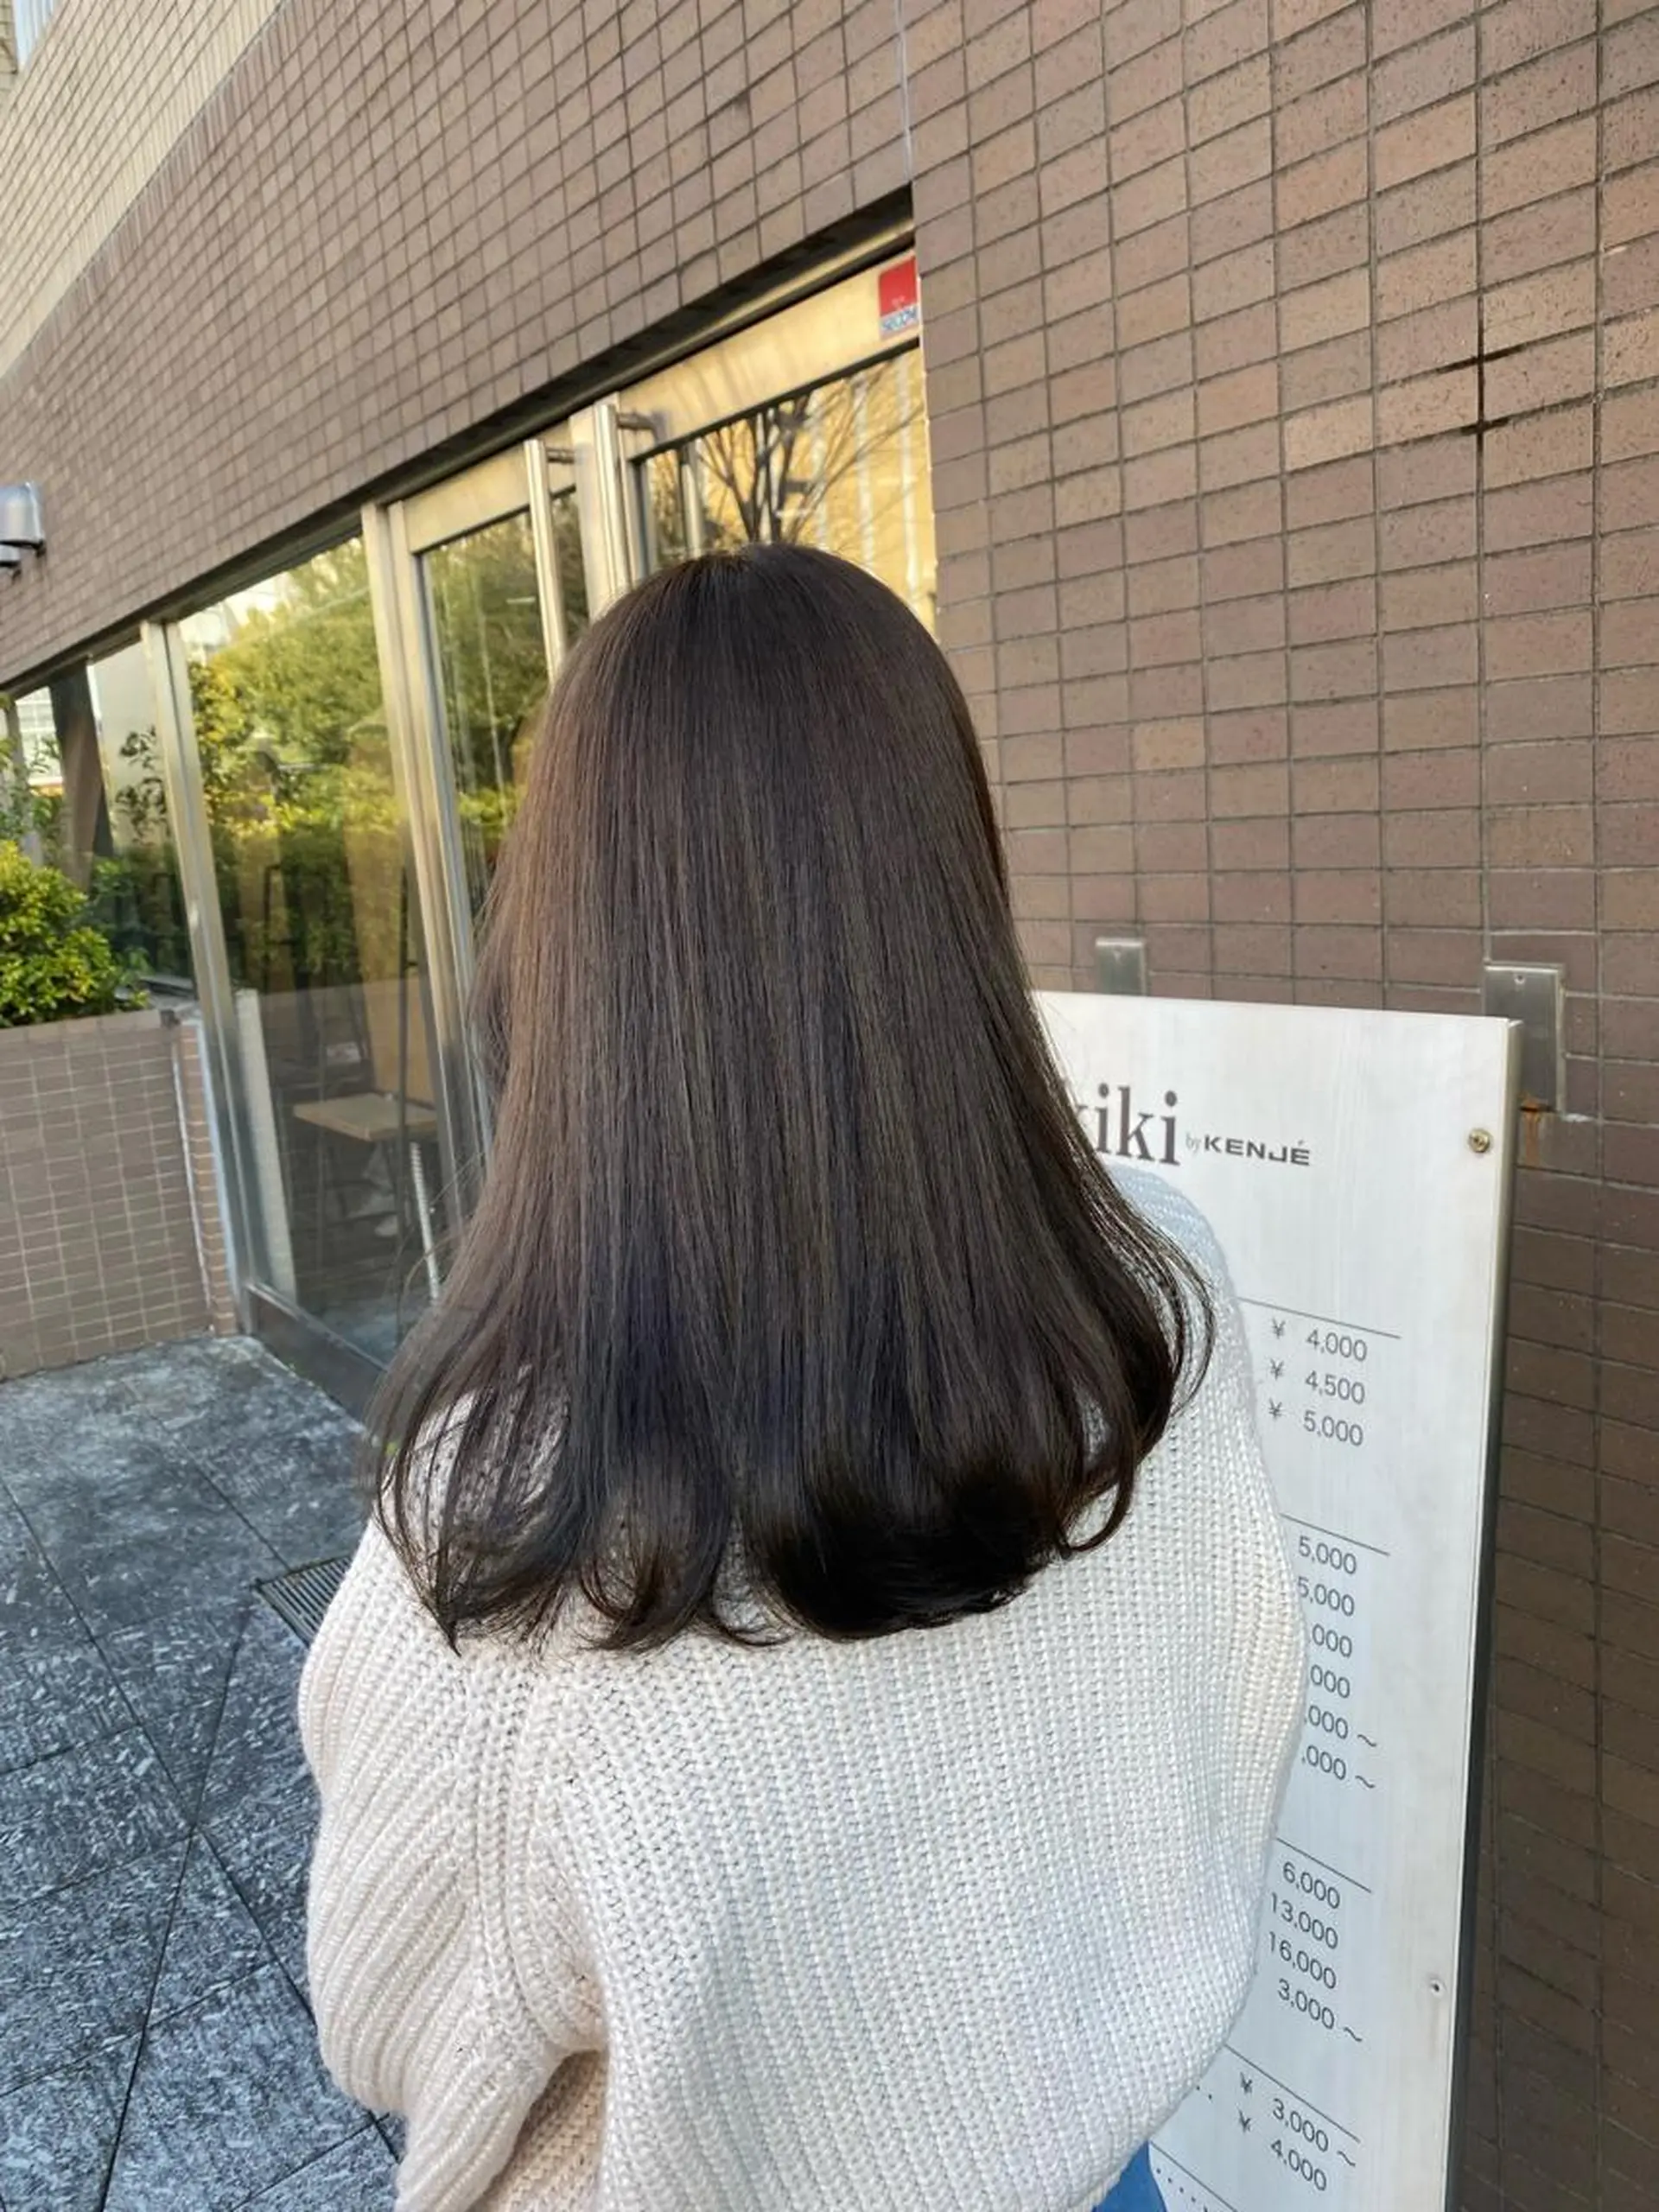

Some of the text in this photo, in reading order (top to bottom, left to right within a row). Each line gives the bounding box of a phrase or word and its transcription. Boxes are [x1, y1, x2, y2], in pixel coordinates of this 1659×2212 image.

[1075, 1083, 1311, 1166] iki by KENJÉ
[1306, 1329, 1368, 1362] 4,000
[1305, 1370, 1365, 1404] 4,500
[1303, 1410, 1363, 1446] 5,000
[1298, 1535, 1357, 1574] 5,000
[1298, 1576, 1355, 1617] 5,000
[1310, 1664, 1351, 1699] 000
[1301, 1745, 1346, 1781] ,000
[1283, 1861, 1340, 1909] 6,000
[1272, 1892, 1338, 1949] 13,000
[1269, 1931, 1336, 1989] 16,000
[1278, 1978, 1334, 2029] 3,000
[1272, 2098, 1329, 2152] 3,000
[1270, 2139, 1327, 2191] 4,000
